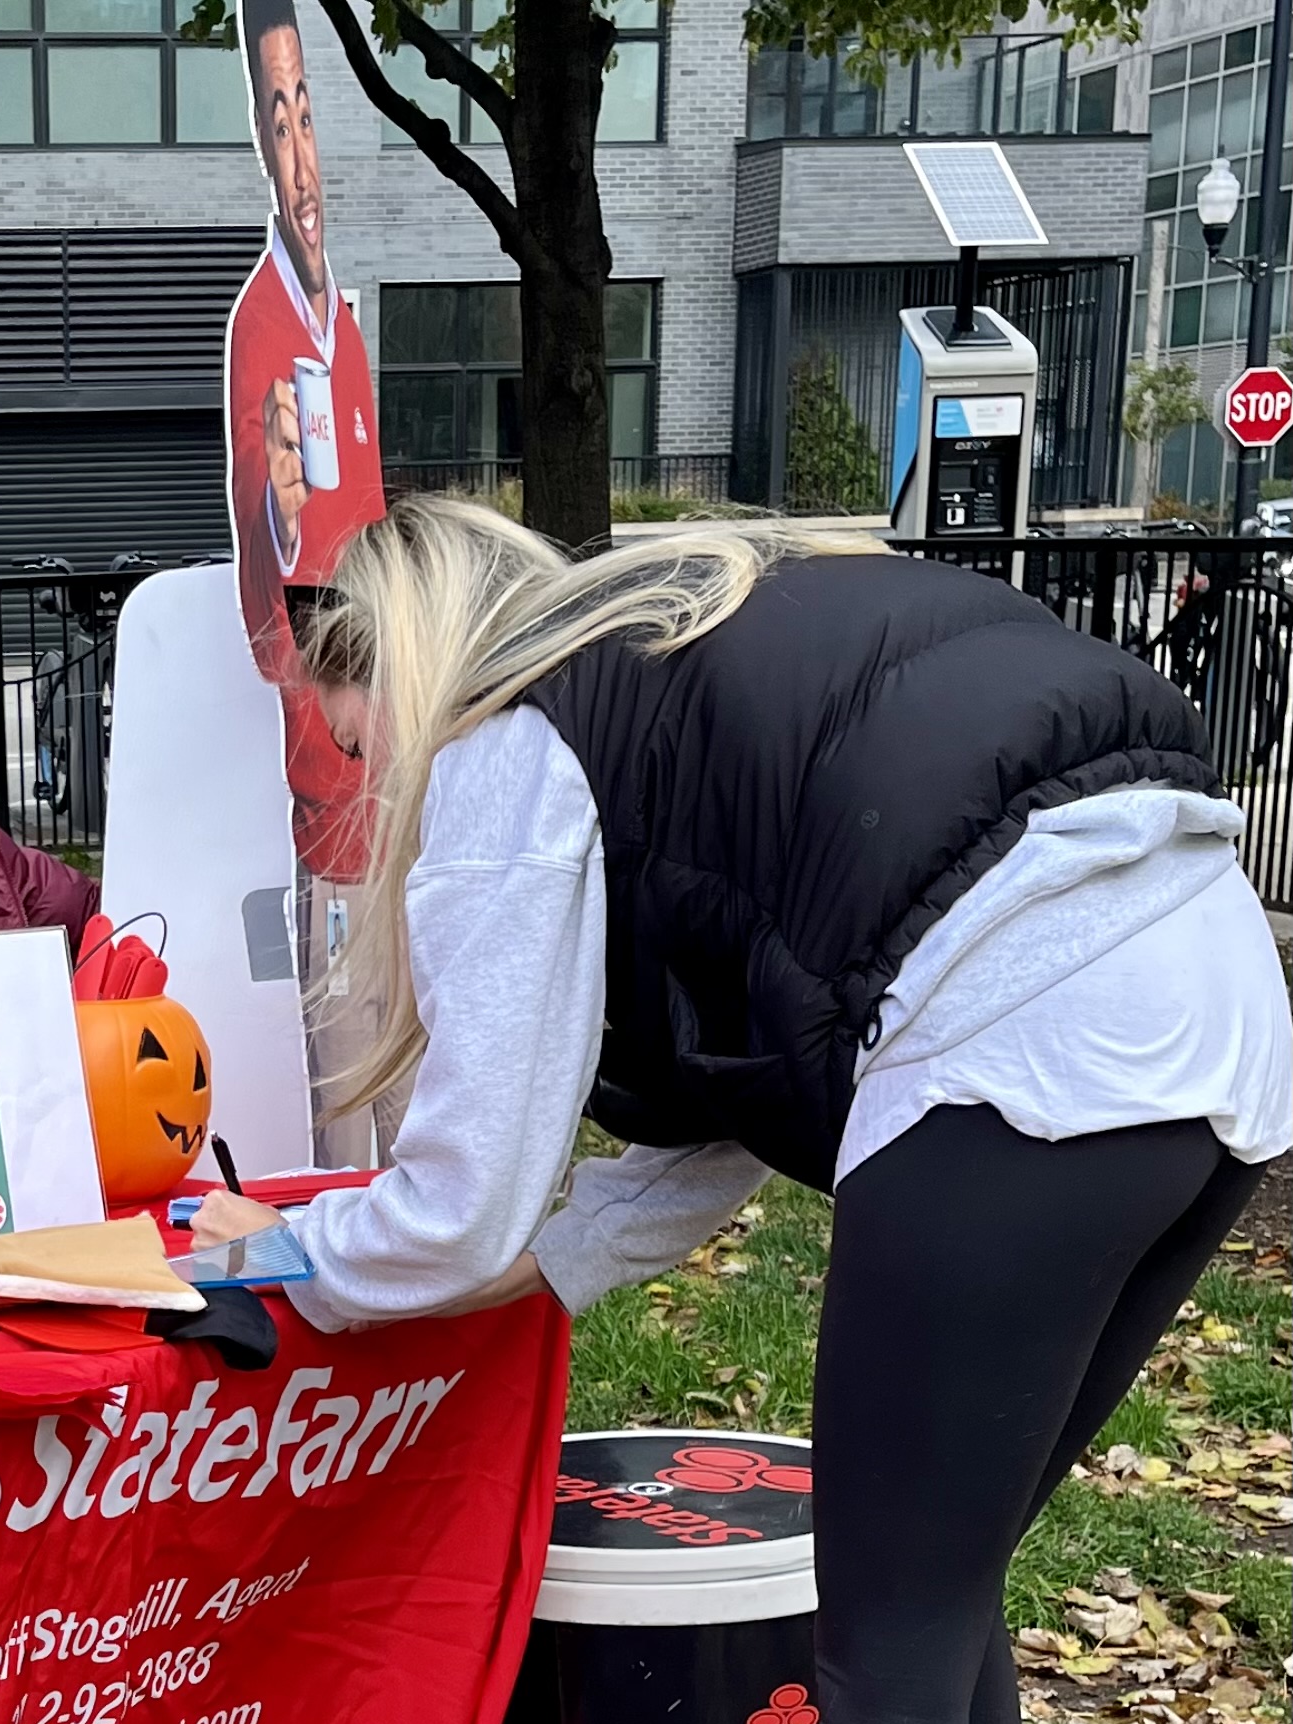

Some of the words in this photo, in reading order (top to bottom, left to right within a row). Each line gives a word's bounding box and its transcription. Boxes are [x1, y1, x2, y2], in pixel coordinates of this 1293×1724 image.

[1231, 391, 1291, 423] STOP
[306, 409, 330, 441] JAKE
[194, 1556, 310, 1624] Agent
